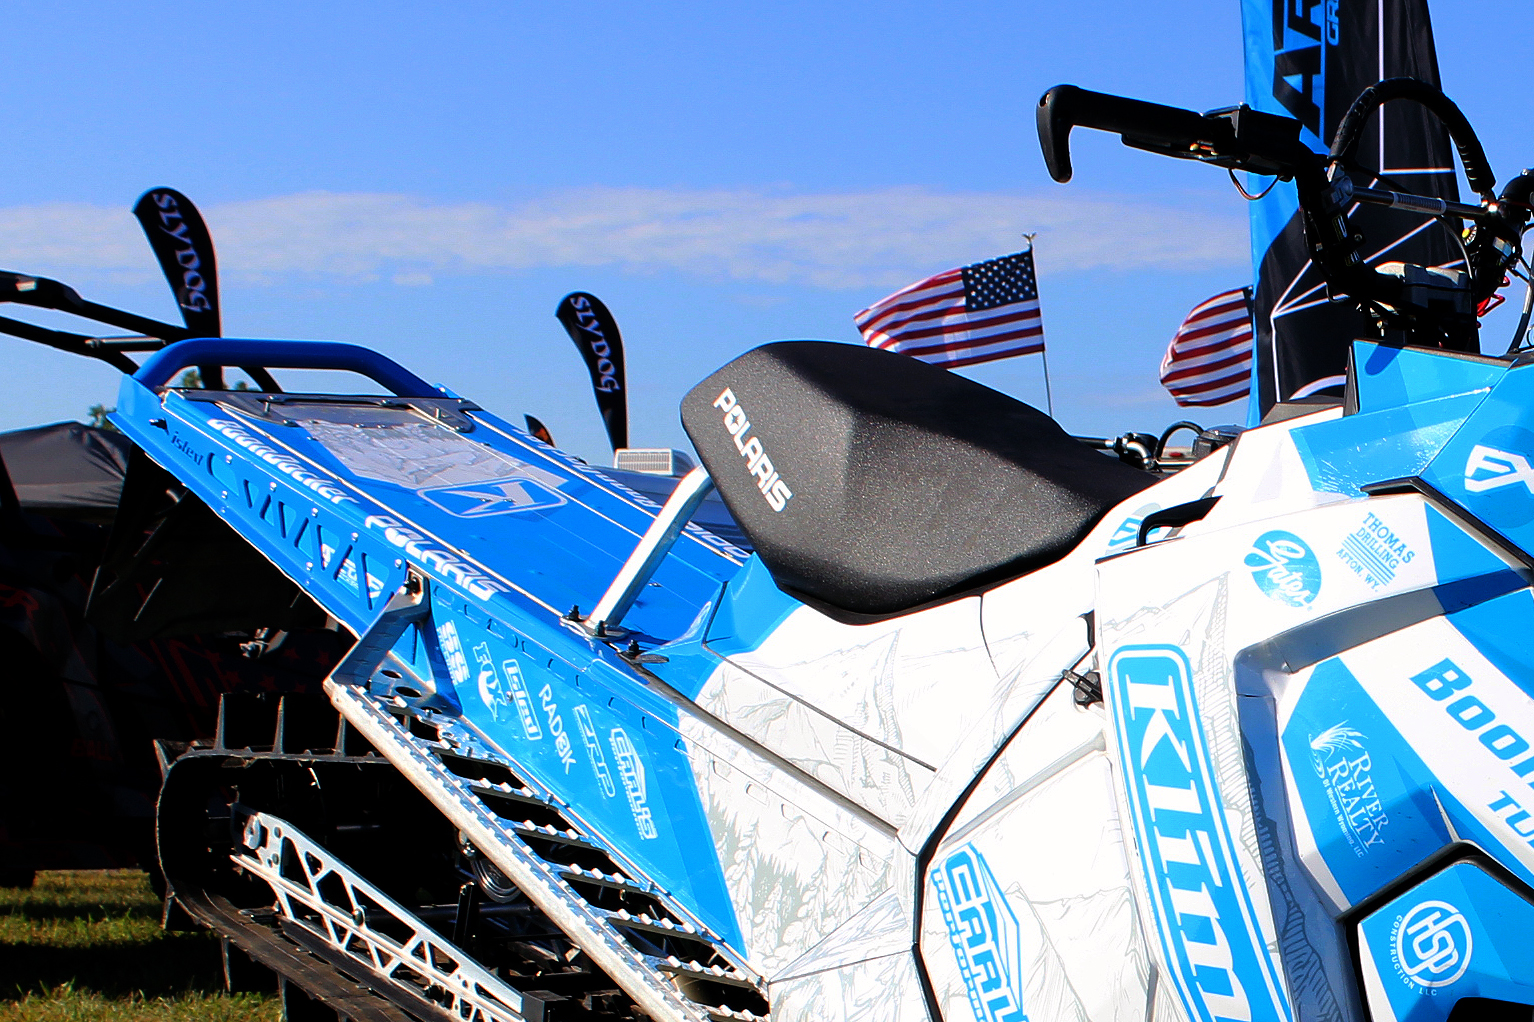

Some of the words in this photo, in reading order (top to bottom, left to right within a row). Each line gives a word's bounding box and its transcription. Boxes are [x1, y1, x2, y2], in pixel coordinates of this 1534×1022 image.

[713, 387, 792, 513] POLARIS
[365, 514, 511, 602] POLARIS
[1355, 526, 1400, 570] DRILLING
[1362, 511, 1416, 564] THOMAS
[472, 641, 509, 711] FOX
[573, 704, 615, 798] ZRP
[1326, 787, 1341, 815] Western
[1326, 756, 1385, 849] REALTY
[1348, 750, 1389, 831] RIVER
[1389, 914, 1416, 990] CONSTRUCTION
